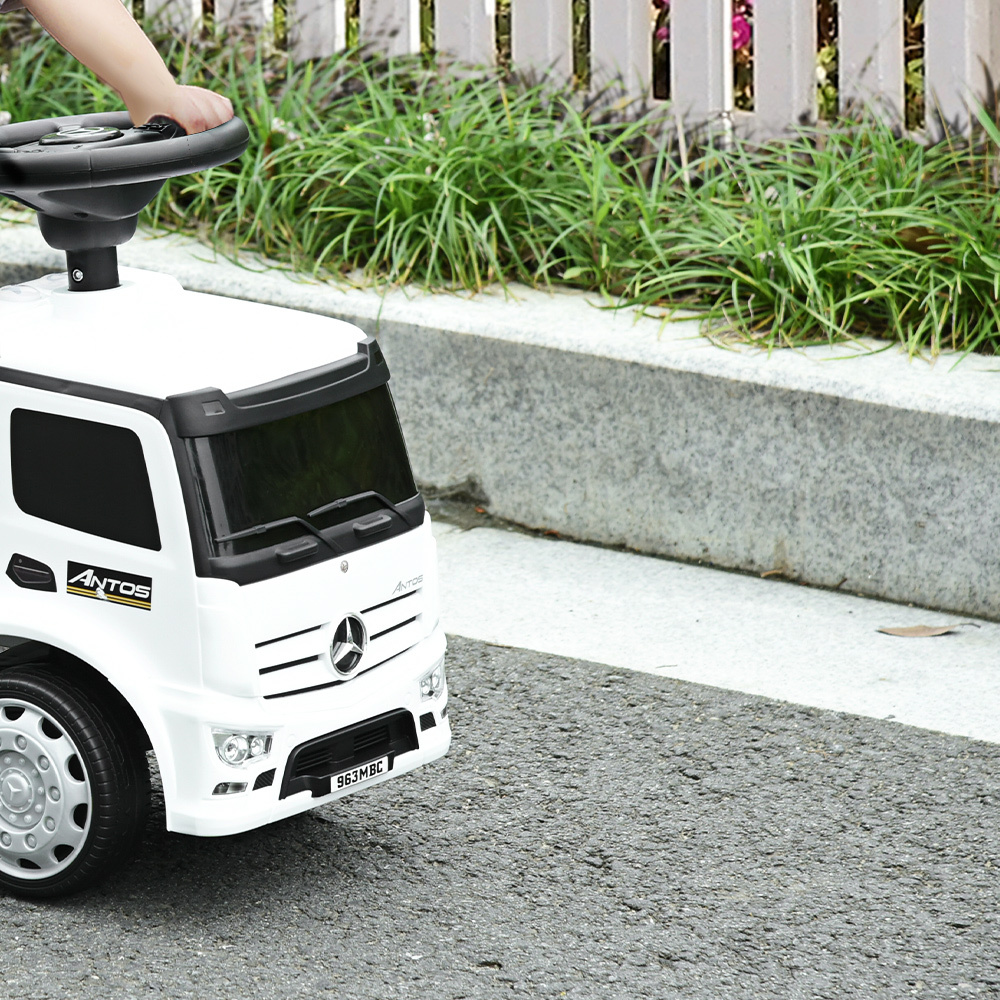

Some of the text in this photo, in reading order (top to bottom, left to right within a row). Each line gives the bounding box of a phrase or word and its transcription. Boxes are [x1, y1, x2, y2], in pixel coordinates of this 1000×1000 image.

[68, 569, 151, 599] ANTOS
[392, 574, 424, 595] ANTOS
[337, 760, 383, 789] 963MBC
